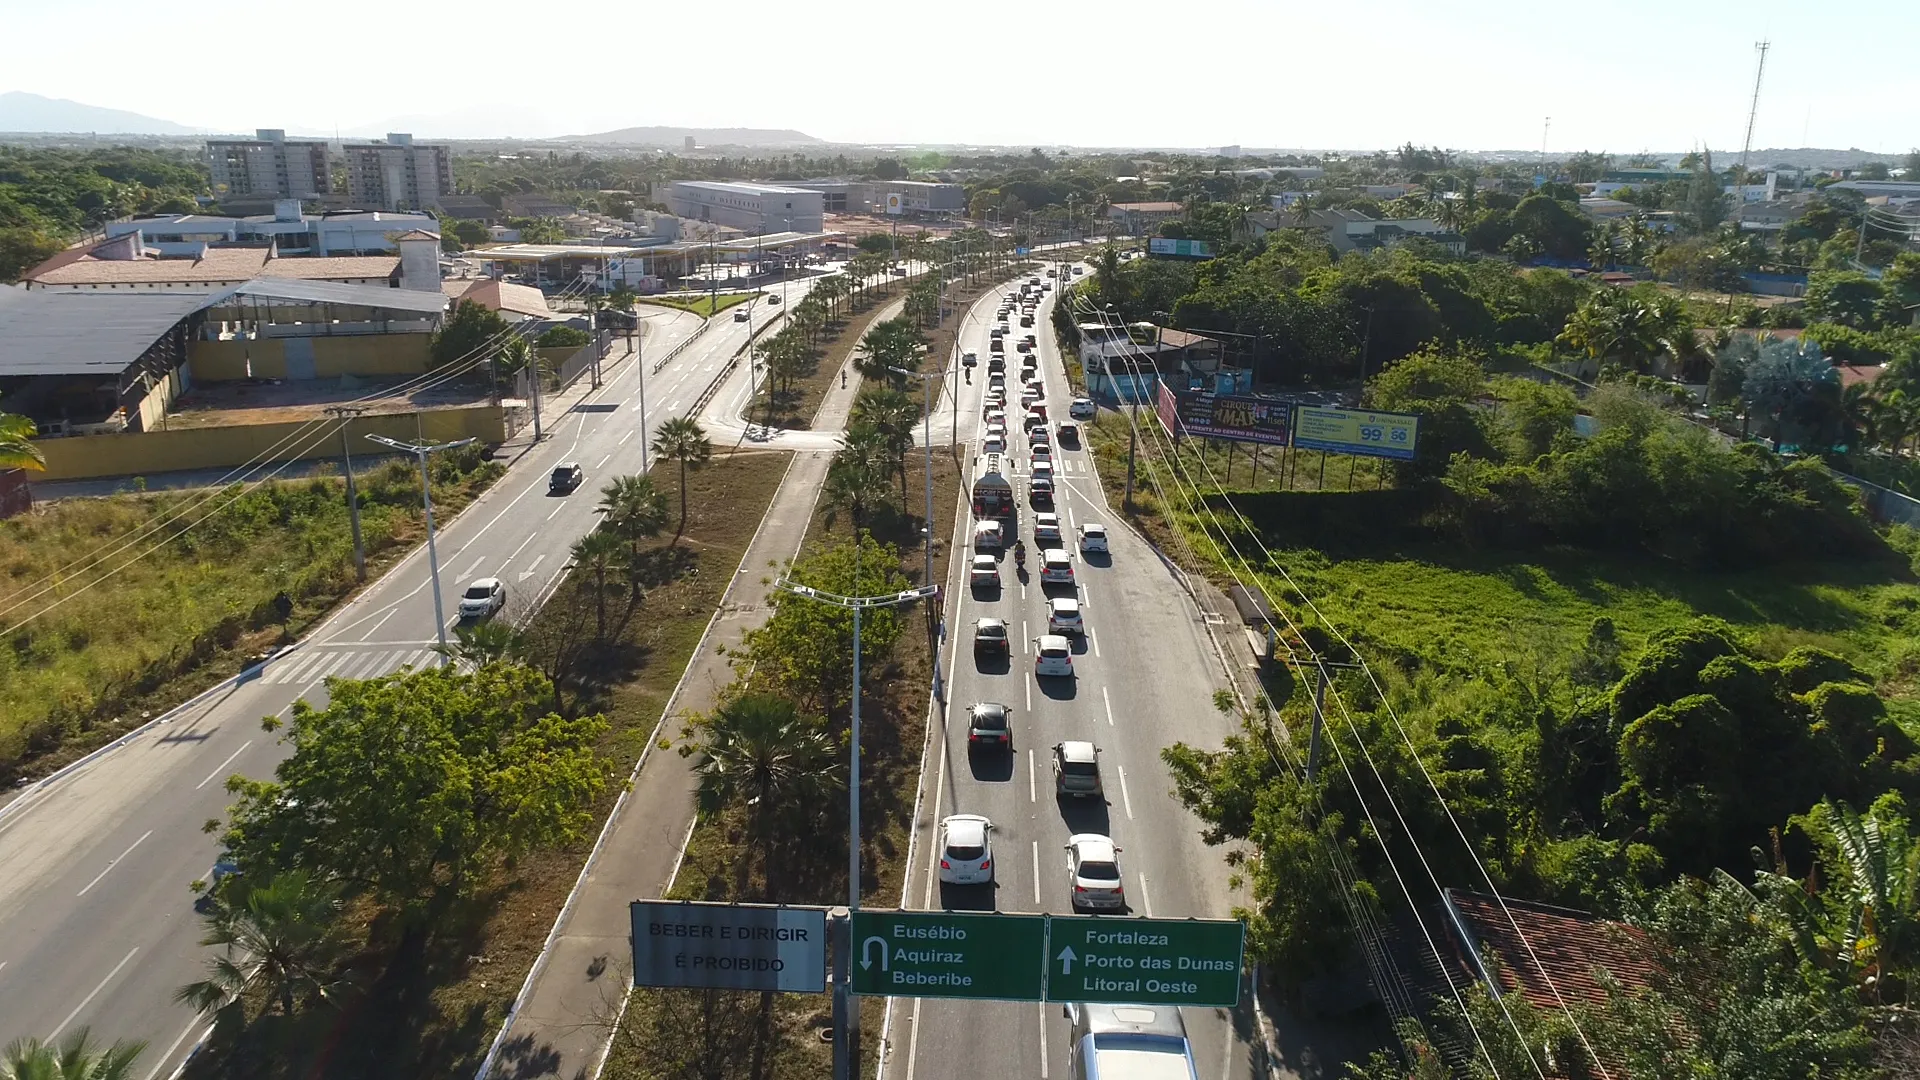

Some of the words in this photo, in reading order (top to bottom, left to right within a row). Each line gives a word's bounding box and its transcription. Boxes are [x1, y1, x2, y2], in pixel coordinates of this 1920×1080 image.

[1221, 400, 1253, 410] CIRQUE
[1214, 408, 1260, 427] AMAR
[1191, 425, 1213, 433] FRENTE
[1254, 432, 1281, 441] EVENTOS
[1361, 427, 1382, 441] 99
[649, 922, 713, 938] BEBER
[720, 926, 731, 939] E
[738, 926, 809, 942] DIRIGIR
[893, 924, 967, 940] Eusébio
[1086, 930, 1169, 945] Fortaleza
[675, 952, 687, 968] É
[693, 956, 785, 972] PROIBIDO
[894, 948, 964, 964] Aquiraz
[1084, 954, 1135, 968] Porto
[1139, 956, 1172, 970] das
[1177, 956, 1235, 971] Dunas
[892, 971, 973, 986] Beberibe
[1083, 977, 1140, 992] Litoral
[1145, 979, 1198, 994] Oeste
